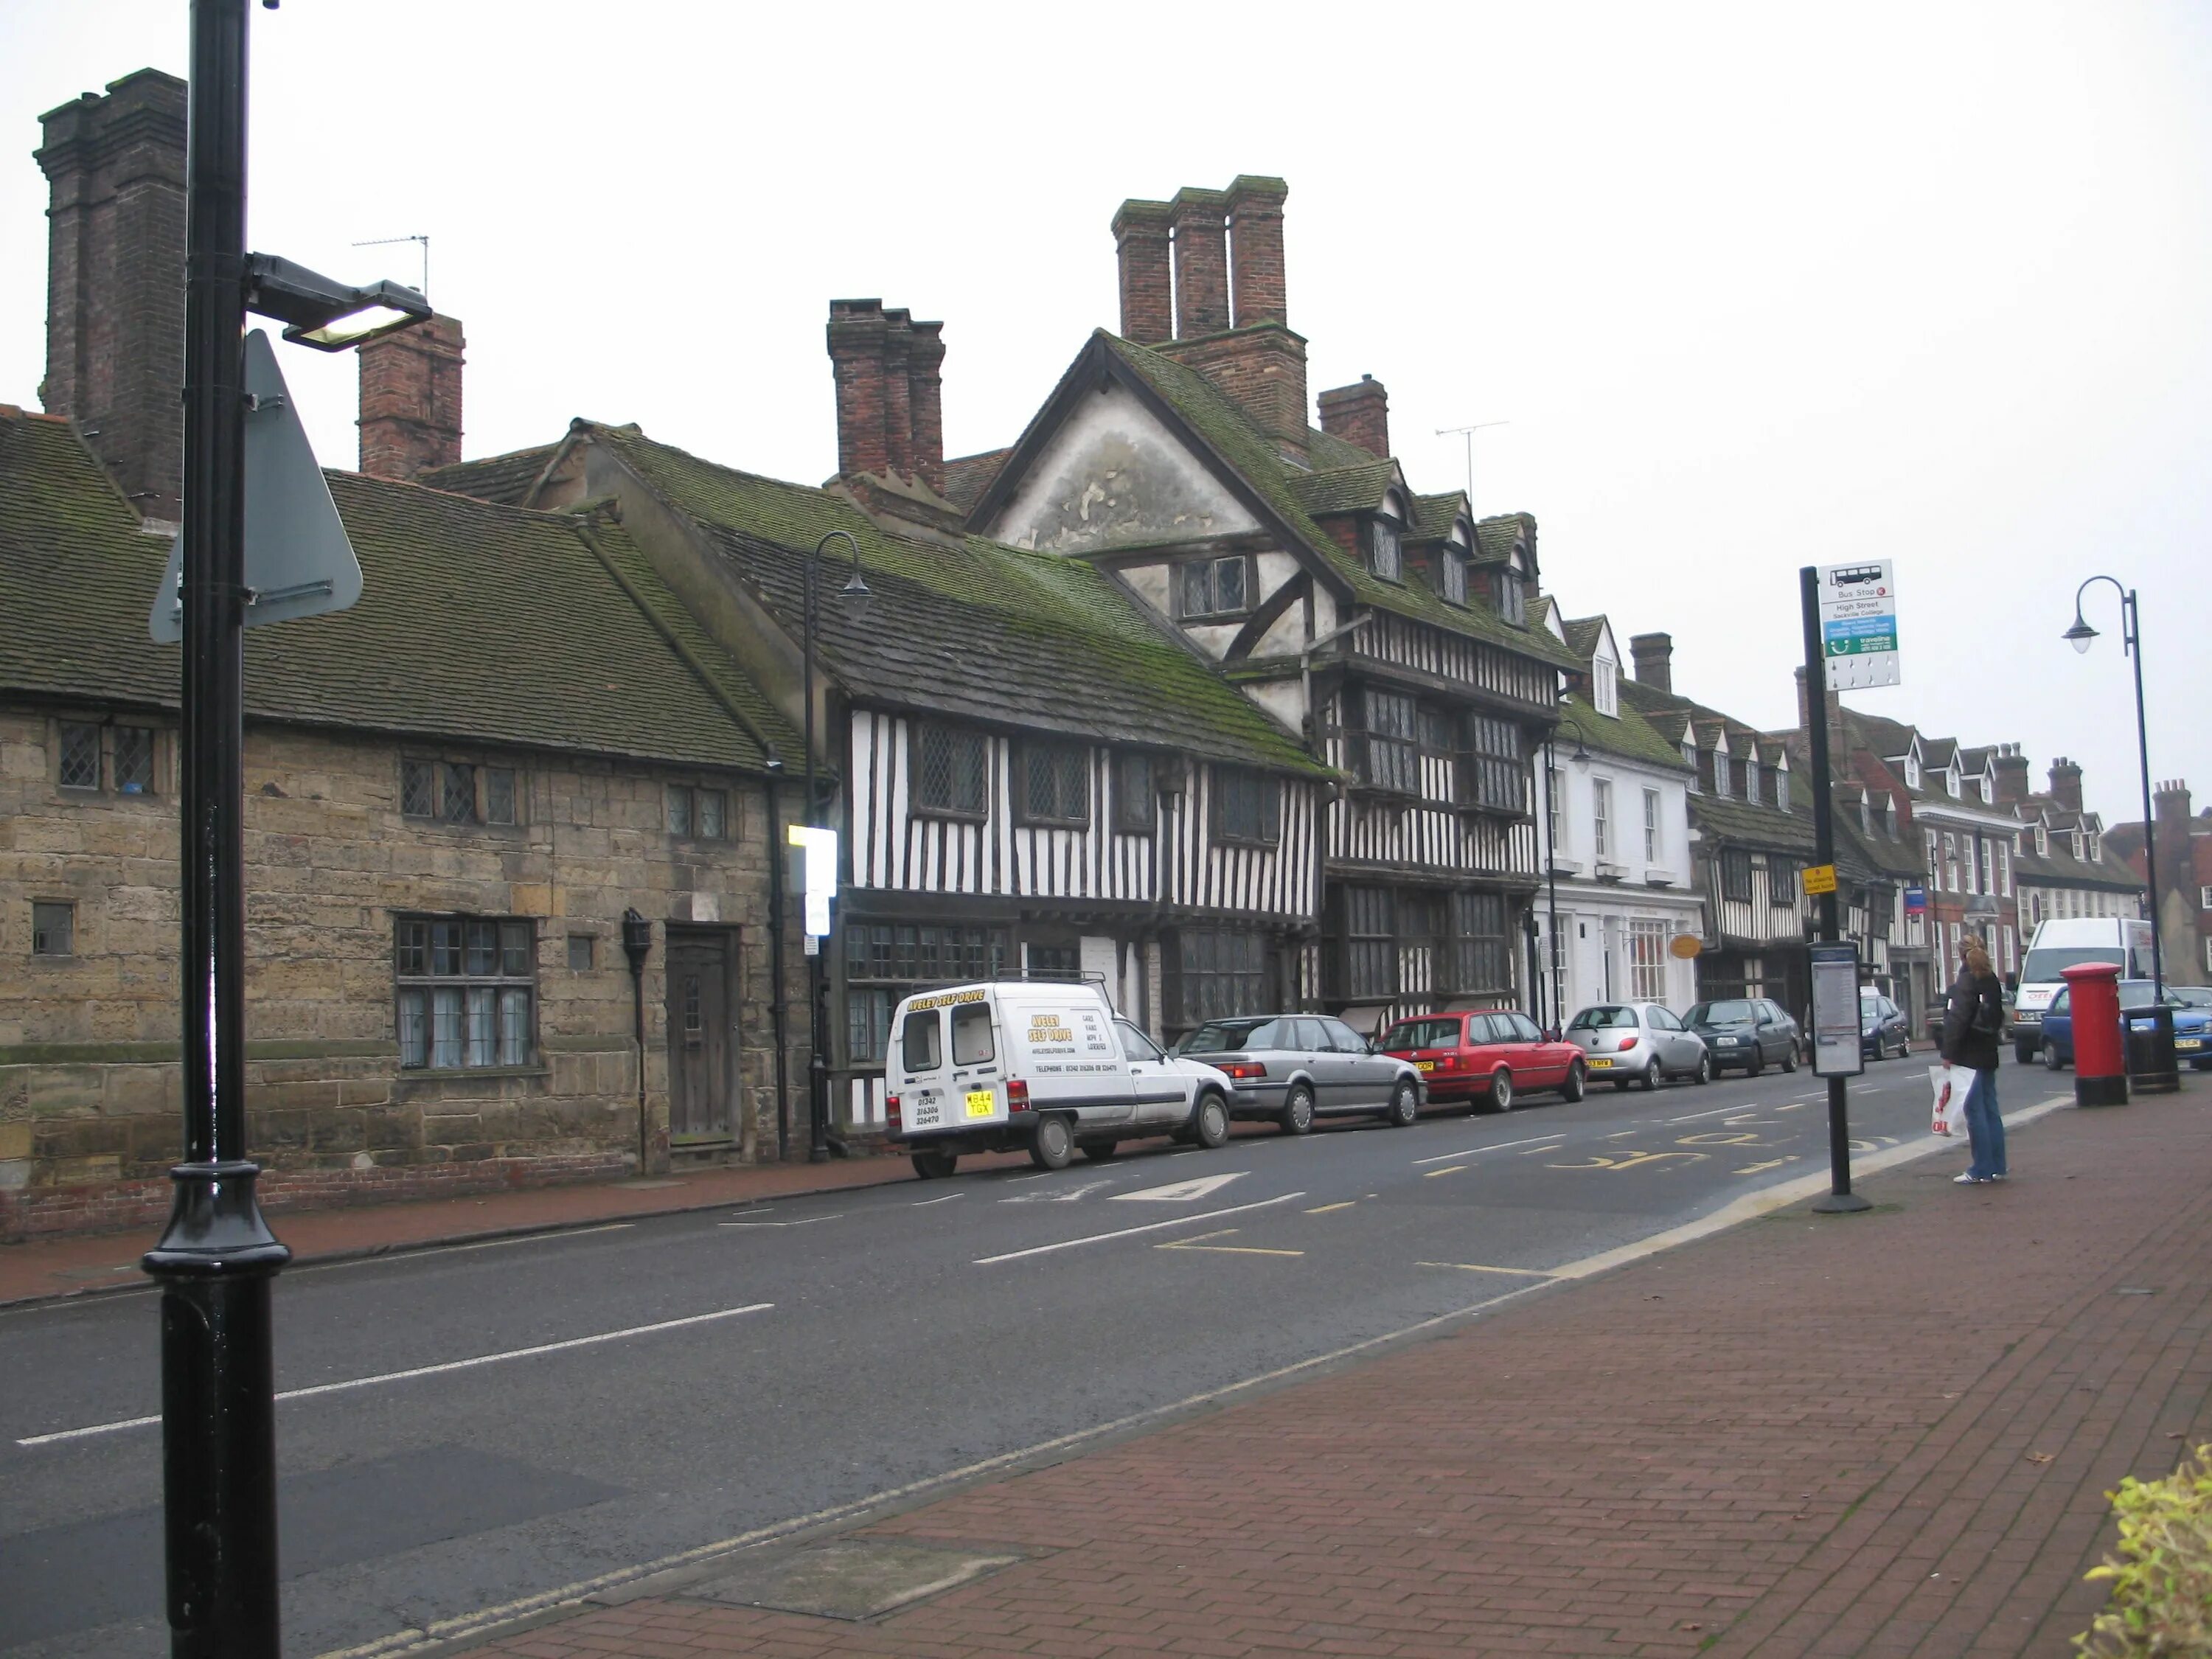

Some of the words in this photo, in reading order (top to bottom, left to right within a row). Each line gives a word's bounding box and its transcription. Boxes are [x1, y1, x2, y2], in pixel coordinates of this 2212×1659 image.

[907, 997, 937, 1012] AVELEY
[937, 992, 957, 1007] SELF
[958, 989, 985, 1003] DRIVE
[1032, 1015, 1060, 1027] AVELEY
[1028, 1029, 1046, 1042] SELF
[1047, 1028, 1072, 1042] DRIVE
[918, 1097, 936, 1106] 01342
[917, 1106, 938, 1115] 316306
[971, 1102, 990, 1114] TGX
[917, 1116, 939, 1124] 326470
